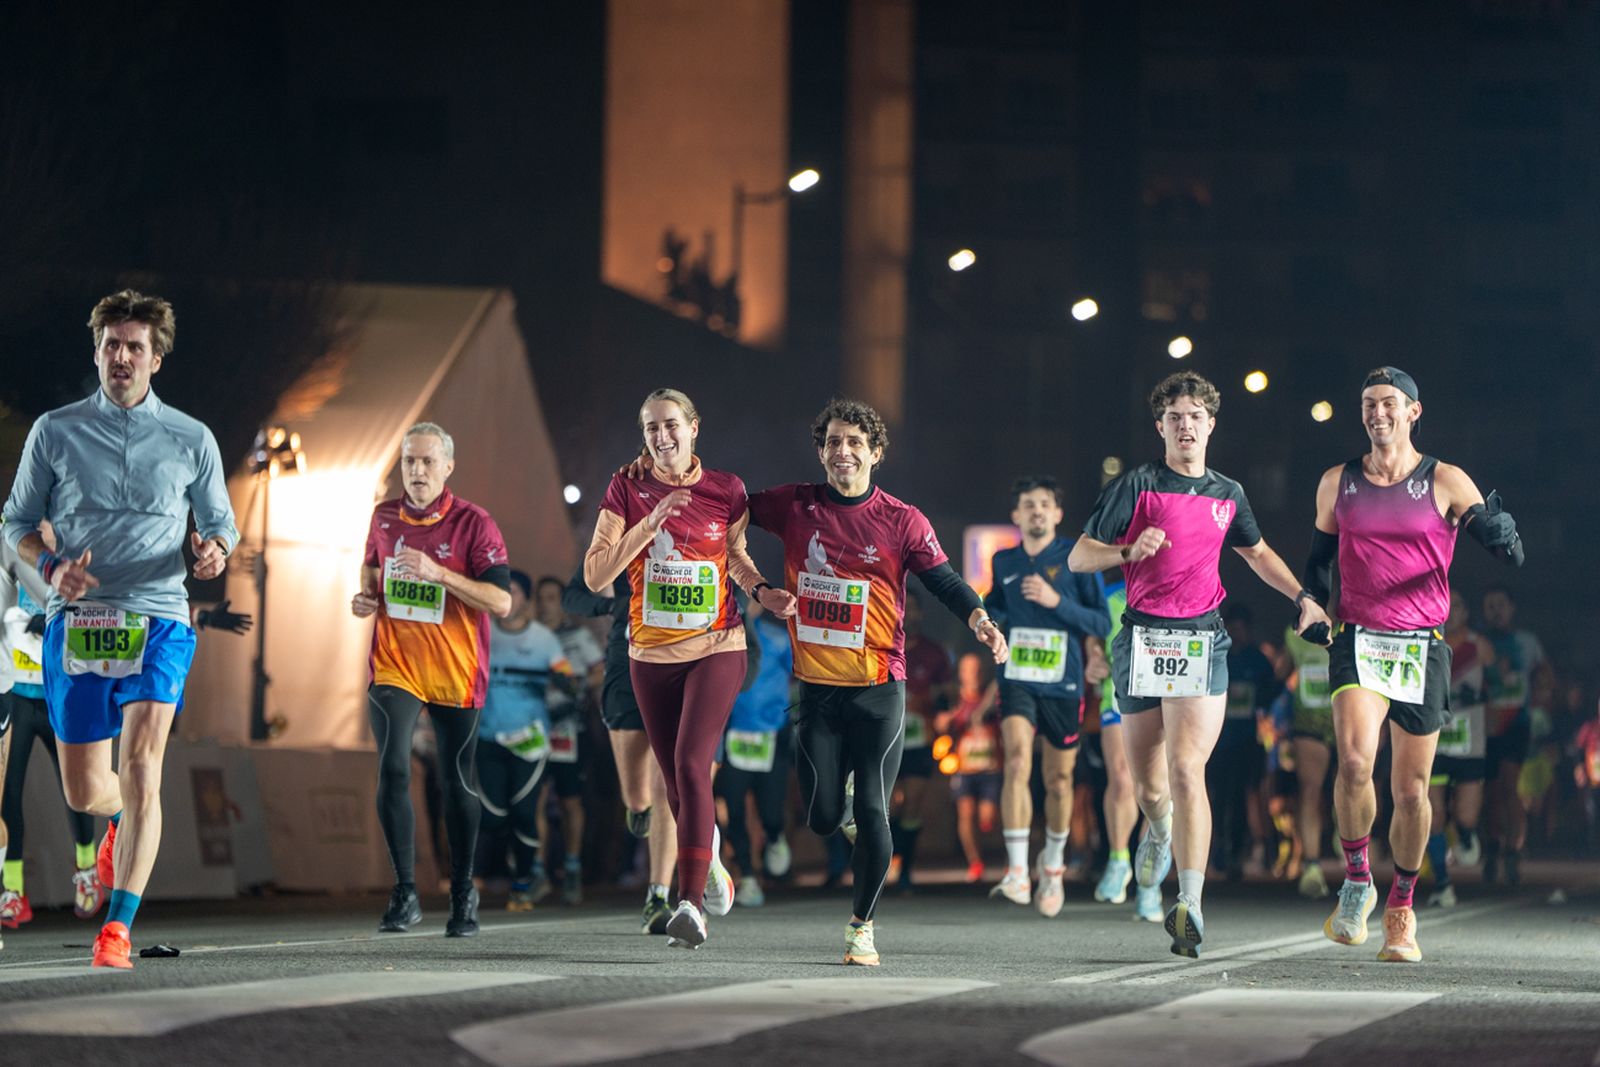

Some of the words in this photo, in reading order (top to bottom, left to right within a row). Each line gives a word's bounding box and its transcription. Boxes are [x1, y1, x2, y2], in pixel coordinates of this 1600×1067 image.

[661, 568, 682, 576] NOCHE
[652, 575, 666, 583] SAN
[391, 580, 436, 603] 13813
[811, 582, 831, 592] NOCHE
[832, 585, 841, 593] DE
[658, 585, 704, 607] 1393
[803, 589, 816, 598] SAN
[81, 609, 106, 617] NOCHE
[108, 609, 118, 617] DE
[807, 600, 852, 625] 1098
[73, 619, 88, 627] SAN
[82, 629, 130, 652] 1193
[1152, 641, 1173, 649] NOCHE
[1153, 657, 1189, 677] 892
